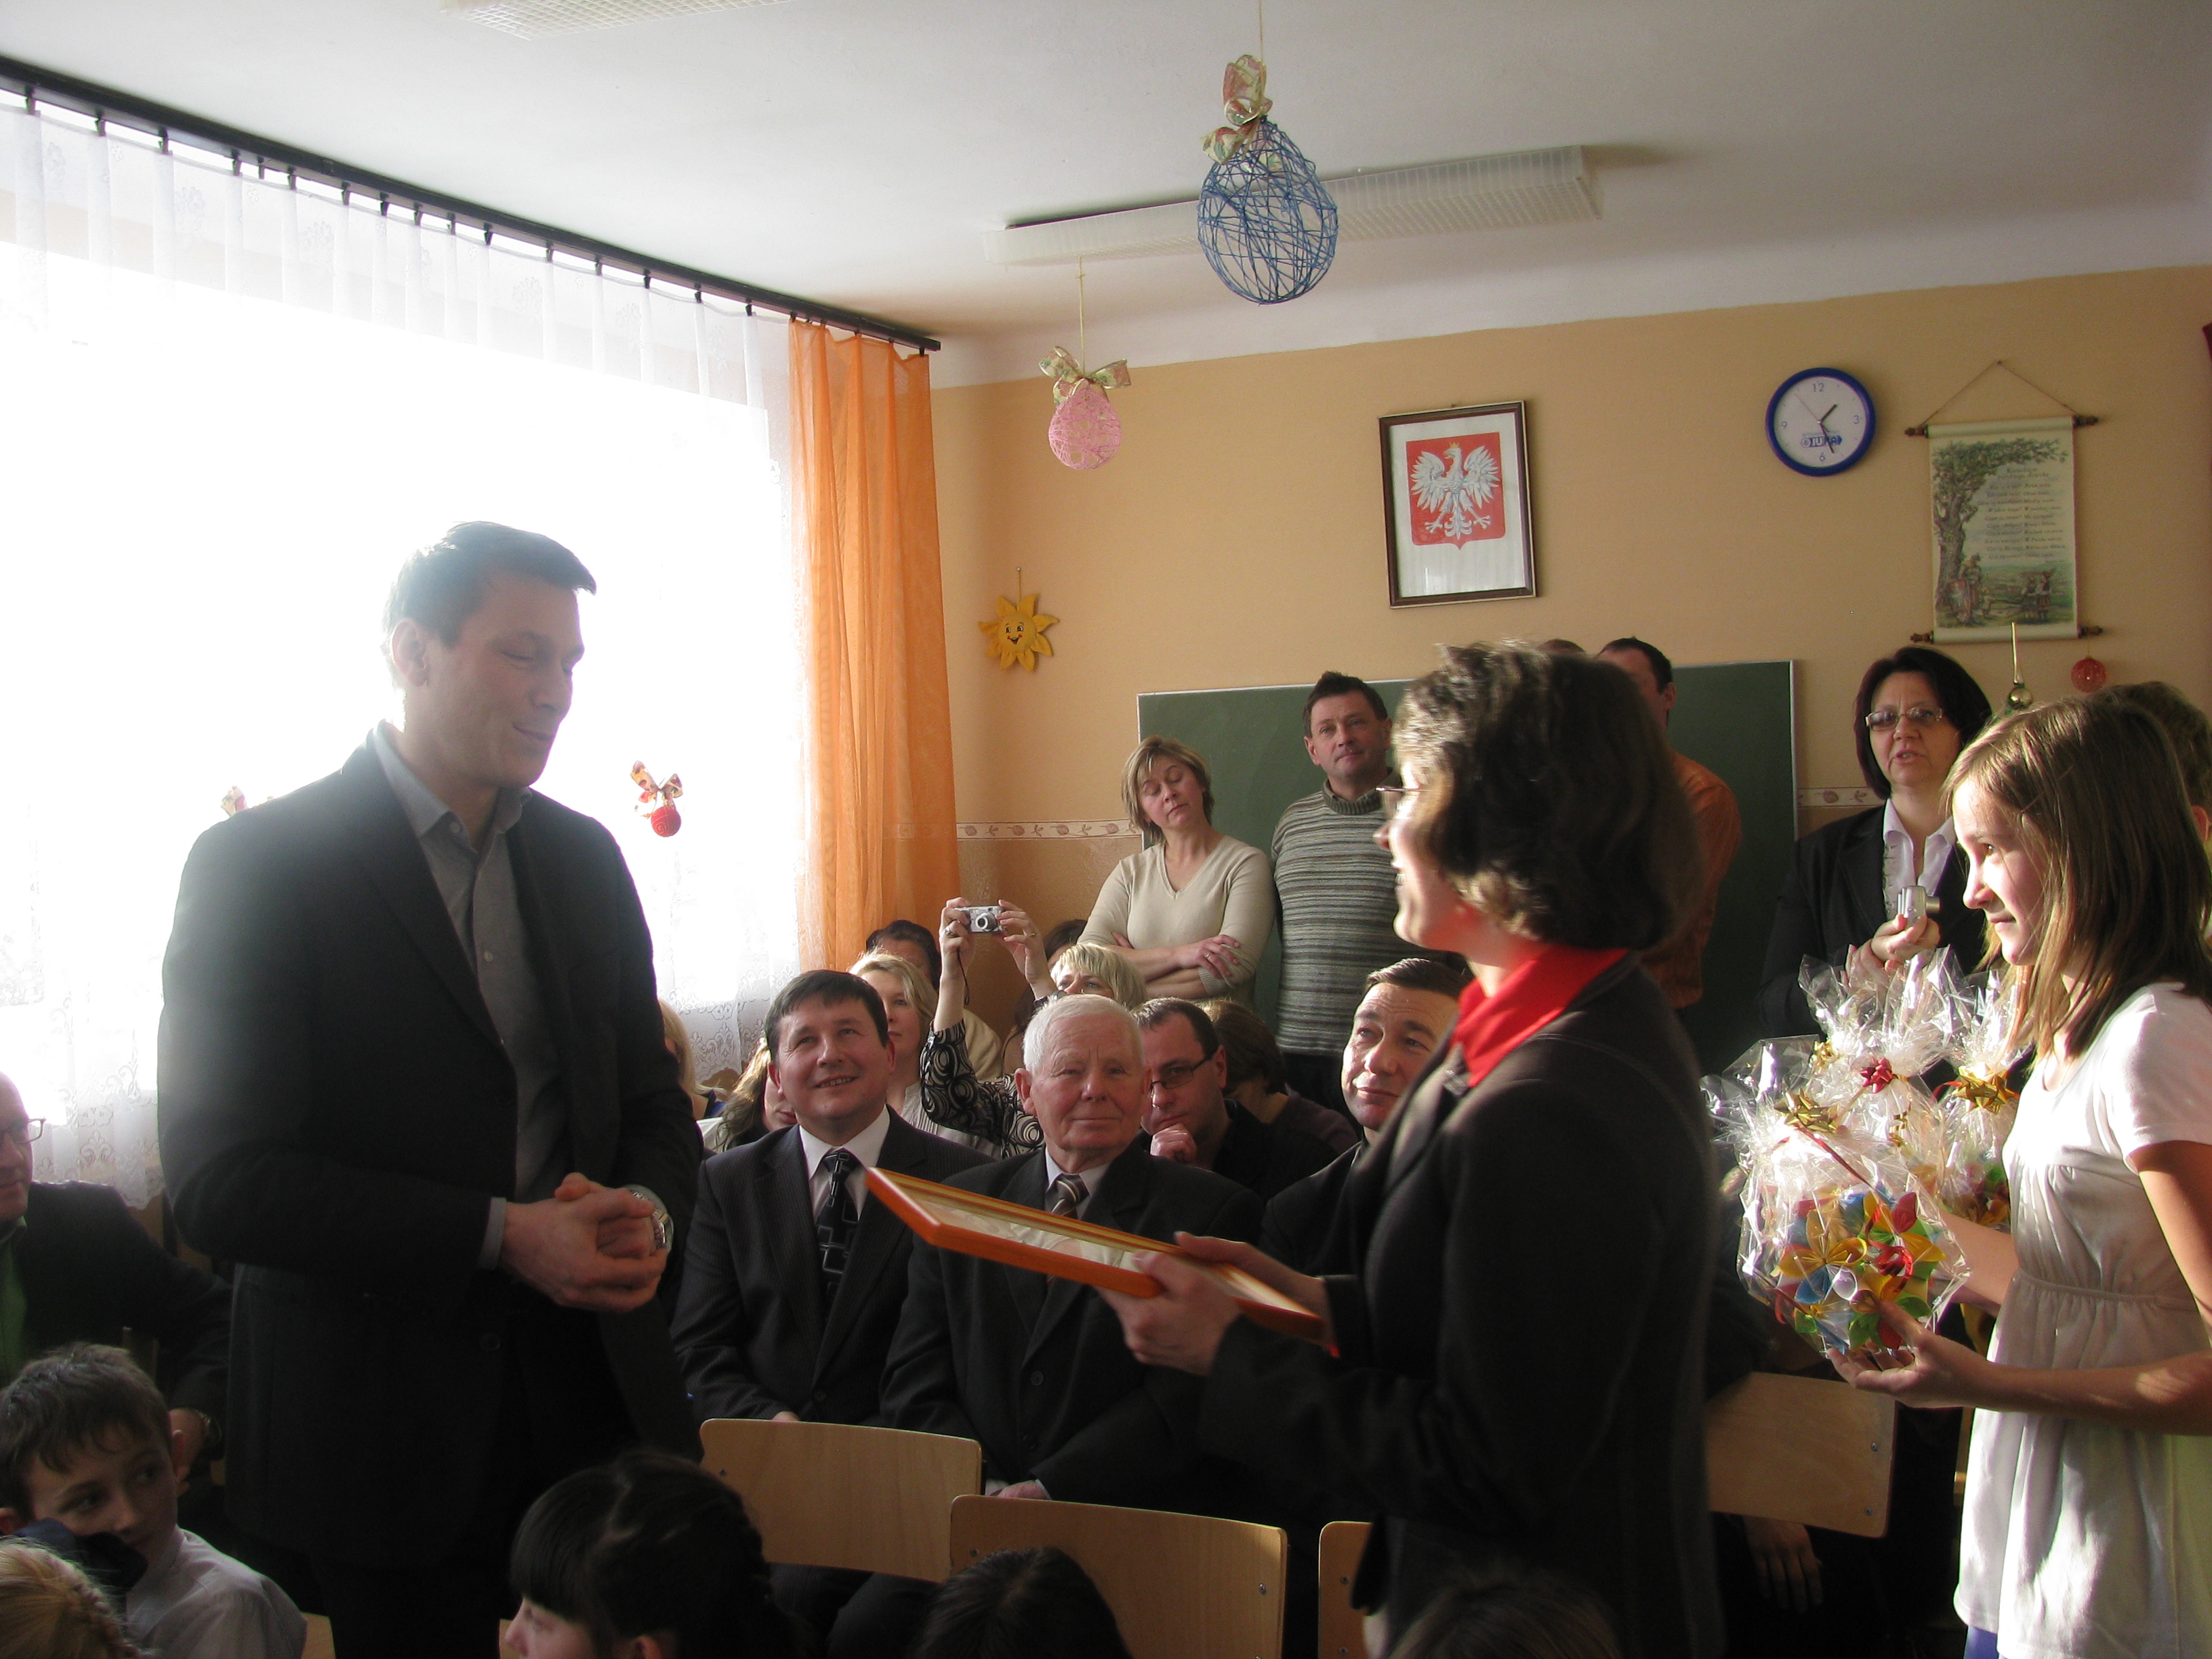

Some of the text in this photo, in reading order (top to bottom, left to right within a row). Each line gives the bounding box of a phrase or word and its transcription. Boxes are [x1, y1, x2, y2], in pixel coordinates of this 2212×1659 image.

[1813, 383, 1824, 392] 12
[1853, 415, 1860, 424] 3
[1819, 453, 1826, 462] 6
